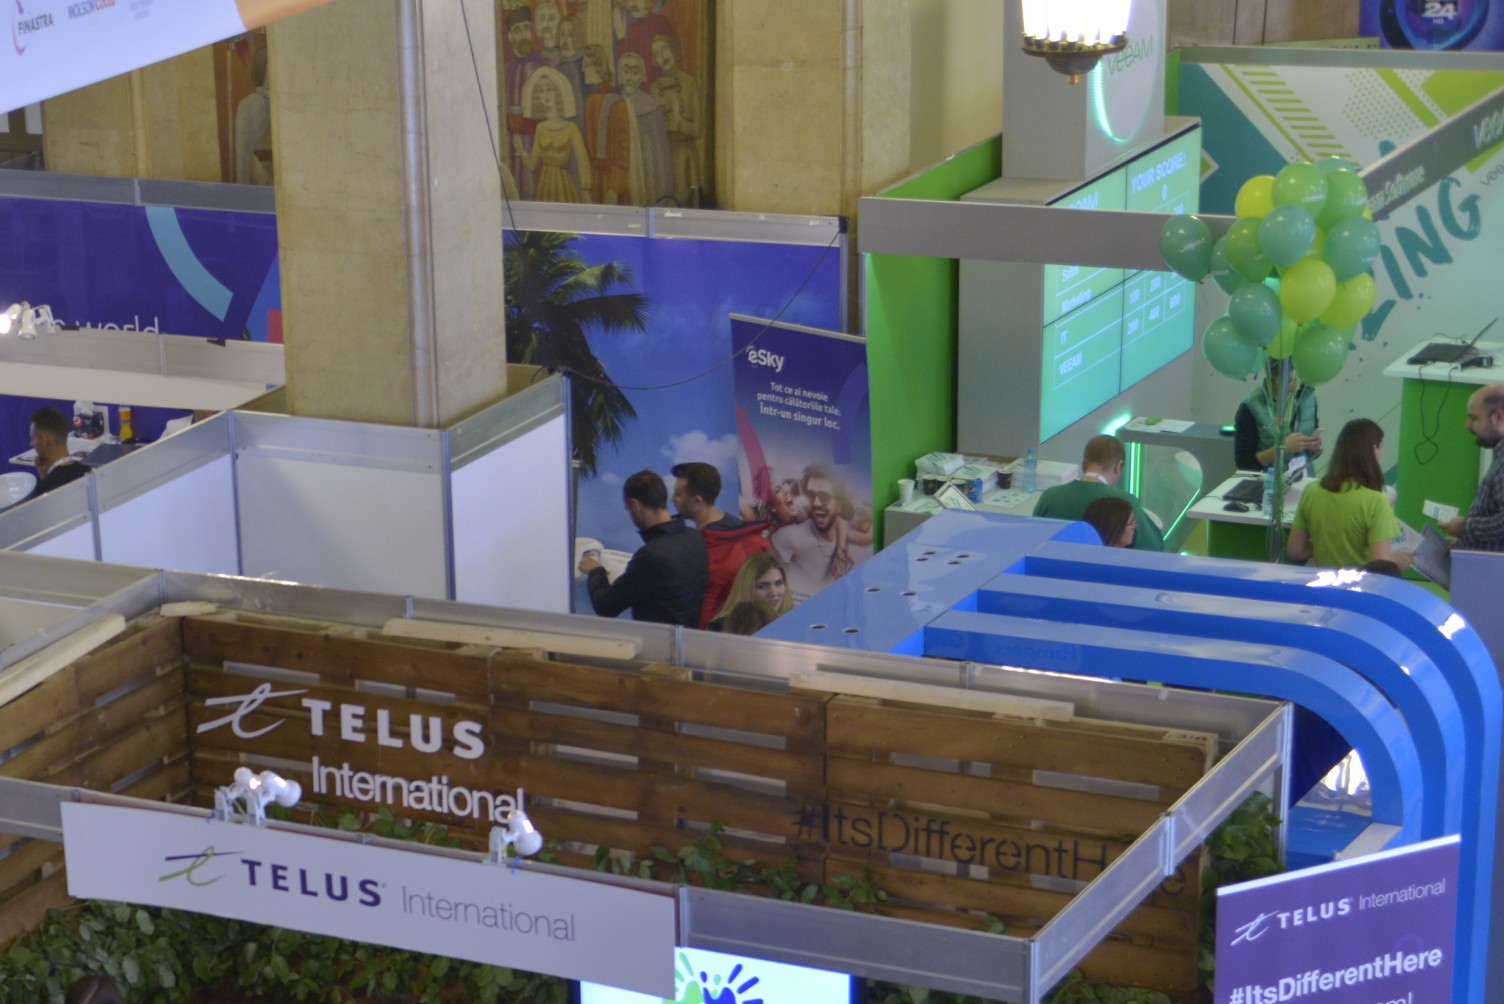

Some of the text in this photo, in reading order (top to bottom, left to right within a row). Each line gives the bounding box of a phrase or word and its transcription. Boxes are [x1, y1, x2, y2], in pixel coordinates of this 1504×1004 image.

[1424, 3, 1457, 20] 24
[18, 13, 54, 36] FINASTRA
[1131, 152, 1186, 194] YOUR SCORE:
[1060, 330, 1067, 344] IT
[748, 349, 785, 373] eSky
[1059, 352, 1083, 376] VEEAM
[757, 392, 783, 404] pentru
[824, 403, 841, 416] tale.
[770, 382, 828, 402] Tot ce ai nevoie
[793, 411, 822, 425] singur
[824, 416, 840, 430] loc.
[301, 698, 485, 760] TELUS
[311, 756, 524, 824] International
[241, 858, 576, 942] TELUS International
[1276, 878, 1446, 929] TELUS International
